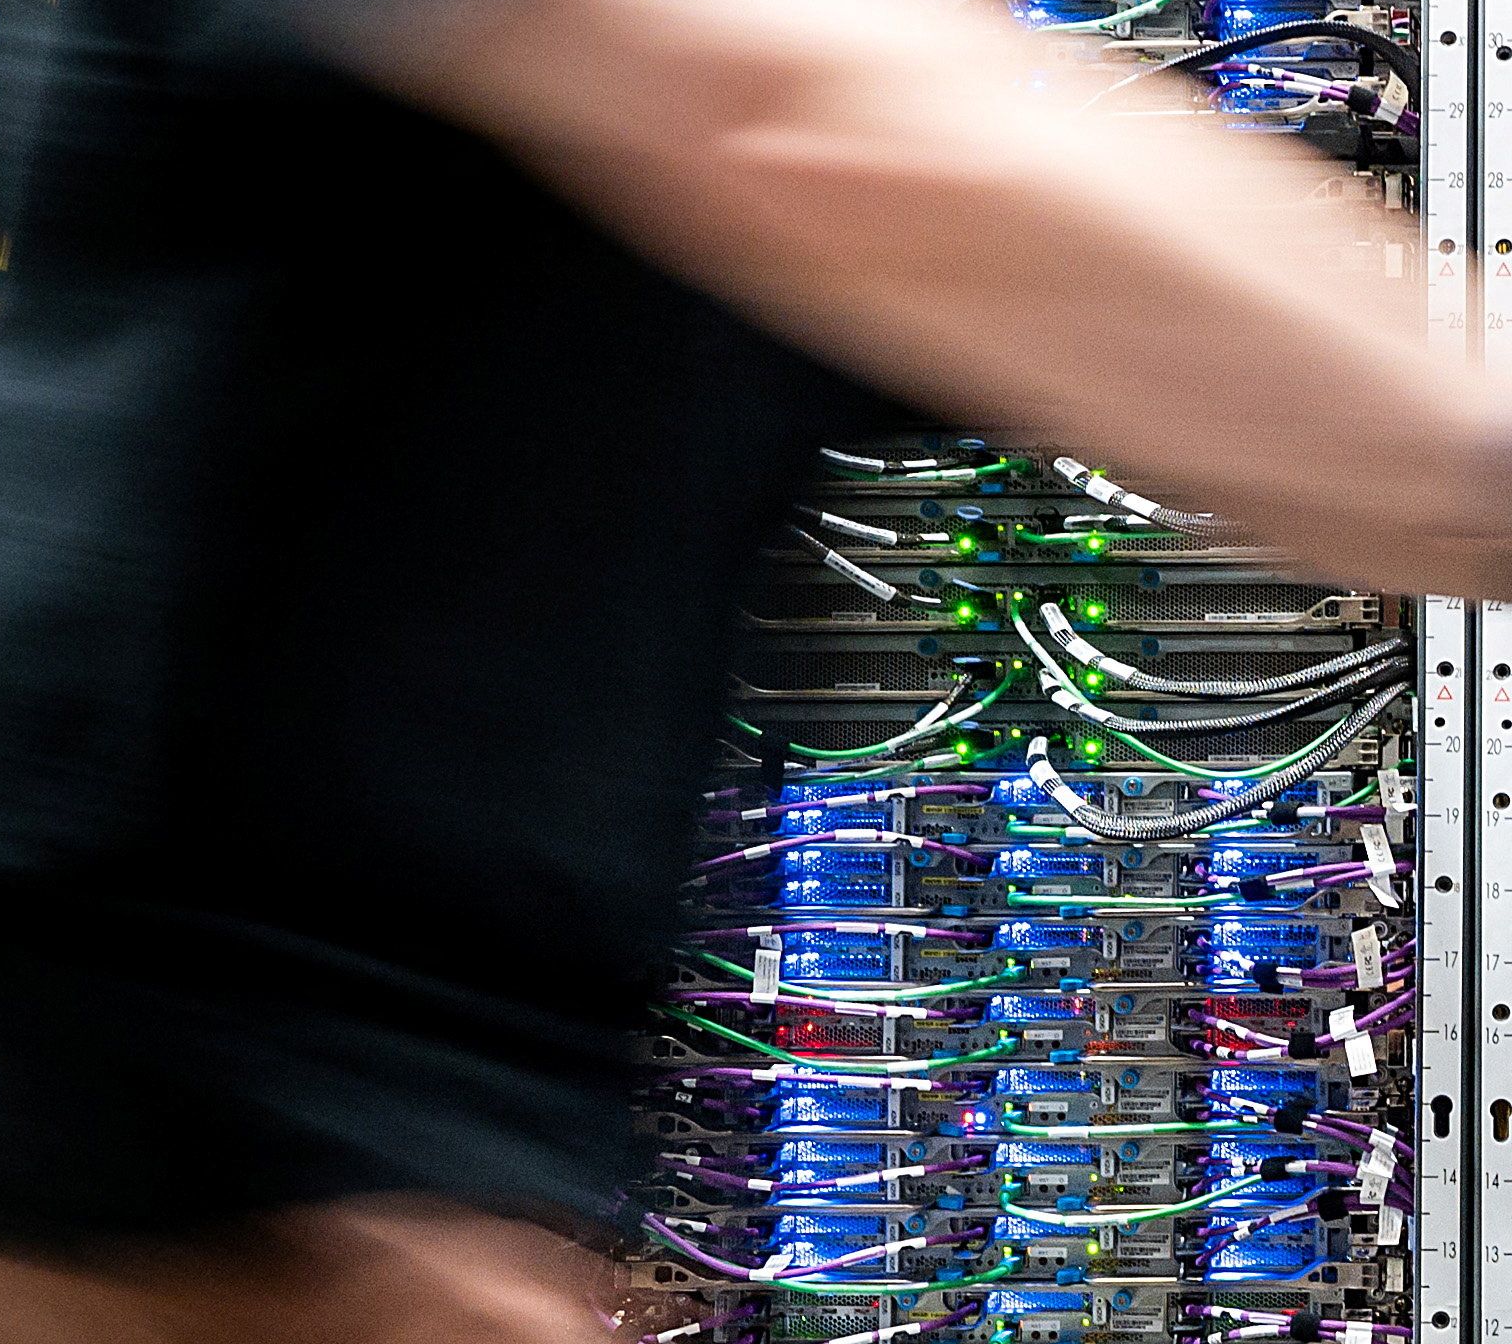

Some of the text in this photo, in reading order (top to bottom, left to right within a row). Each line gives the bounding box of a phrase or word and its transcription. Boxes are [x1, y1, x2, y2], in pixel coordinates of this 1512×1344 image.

[1450, 103, 1464, 119] 29
[1489, 102, 1503, 118] 29
[1450, 174, 1464, 190] 28
[1488, 173, 1502, 189] 28
[1449, 313, 1463, 329] 26
[1488, 313, 1503, 329] 26
[1446, 736, 1460, 752] 20
[1487, 738, 1501, 754] 20
[1447, 808, 1459, 823] 19
[1487, 811, 1499, 826] 19
[1487, 883, 1499, 899] 18
[1445, 951, 1458, 967] 17
[1487, 954, 1499, 970] 17
[1445, 1024, 1457, 1040] 16
[1486, 1028, 1499, 1044] 16
[1443, 1169, 1456, 1185] 14
[1486, 1173, 1499, 1189] 14
[1443, 1242, 1456, 1258] 13
[1486, 1246, 1498, 1263] 13
[1486, 1319, 1498, 1336] 12
